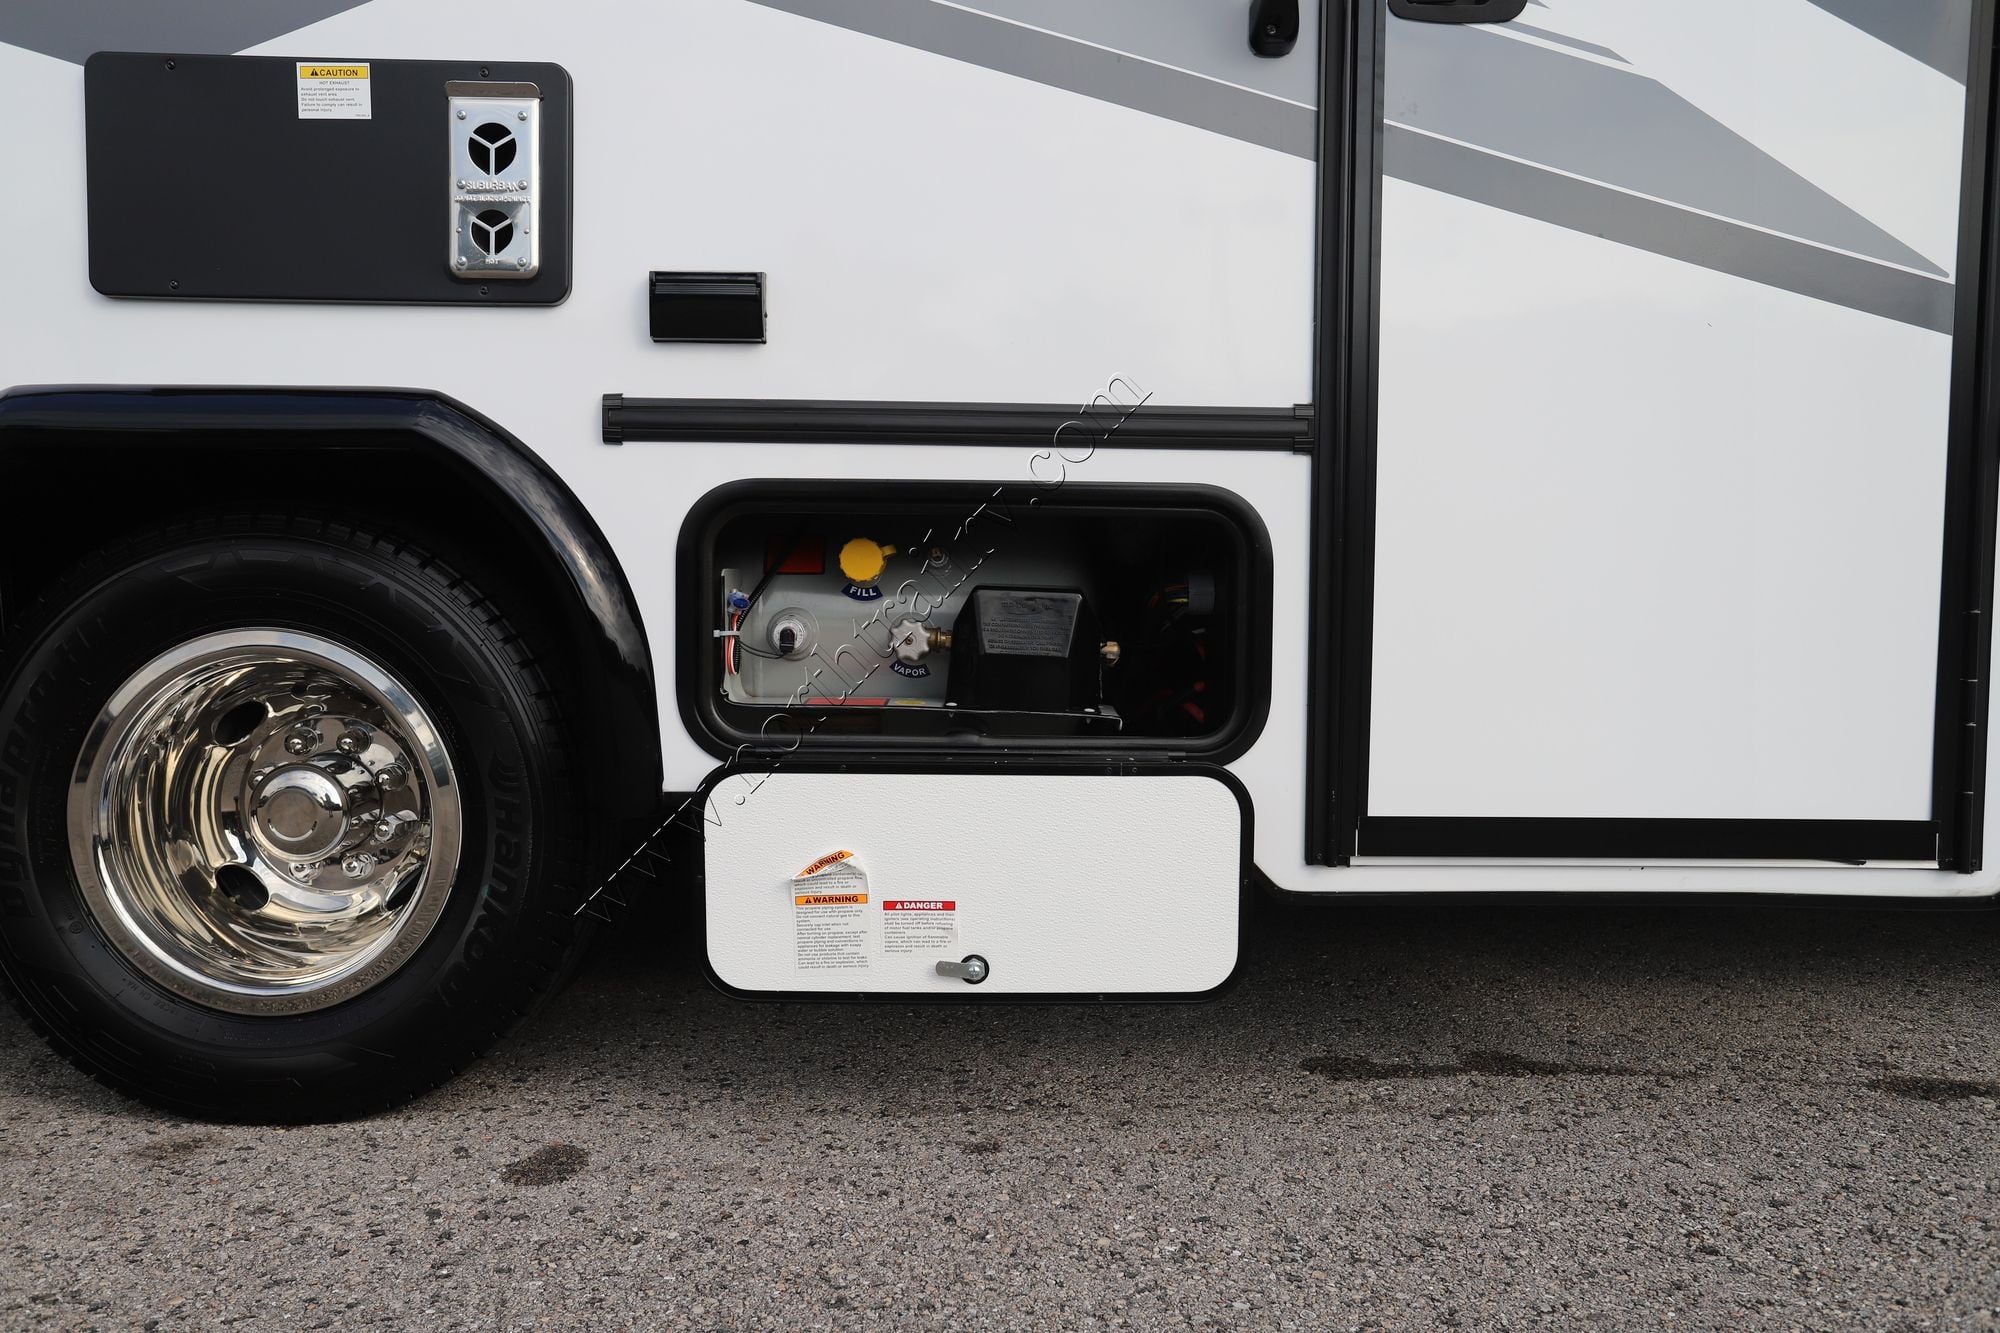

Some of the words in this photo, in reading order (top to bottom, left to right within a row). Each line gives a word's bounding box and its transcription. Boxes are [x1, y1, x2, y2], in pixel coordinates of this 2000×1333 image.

[466, 180, 518, 192] SUBURBAN
[850, 586, 877, 598] FILL
[892, 664, 928, 677] VAPOR
[806, 852, 845, 875] WARNING
